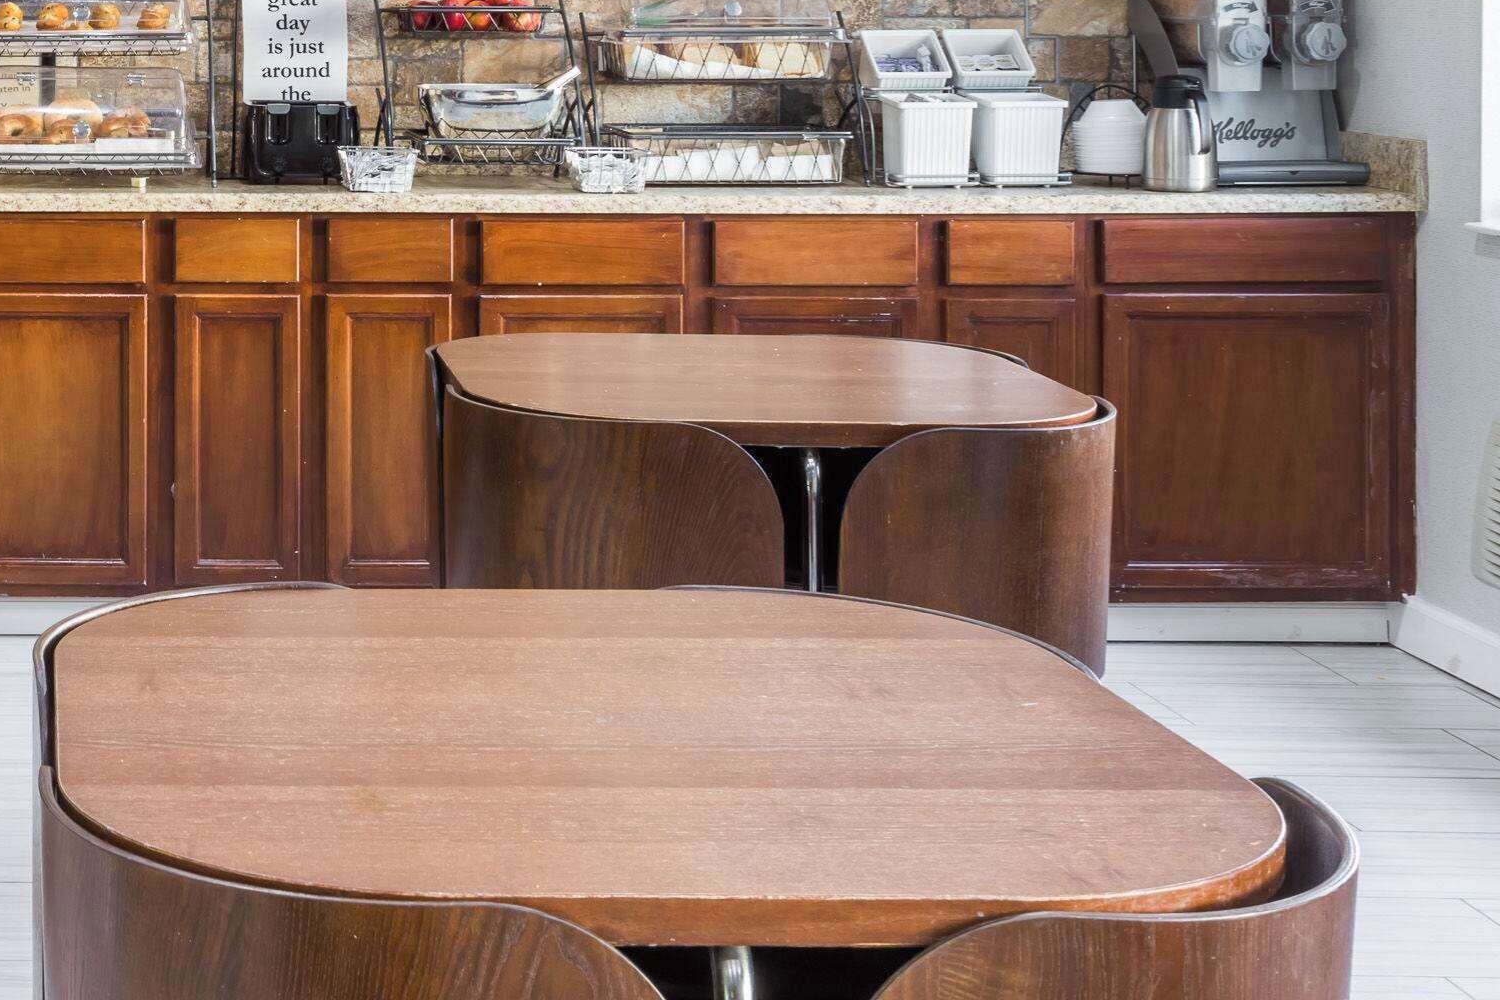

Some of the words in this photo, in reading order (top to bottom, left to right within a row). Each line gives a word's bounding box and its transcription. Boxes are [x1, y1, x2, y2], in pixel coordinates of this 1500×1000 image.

[275, 13, 311, 36] day
[267, 38, 283, 55] is
[289, 38, 325, 59] just
[261, 62, 331, 78] around
[280, 86, 312, 102] the
[1212, 117, 1297, 149] Kellogg's
